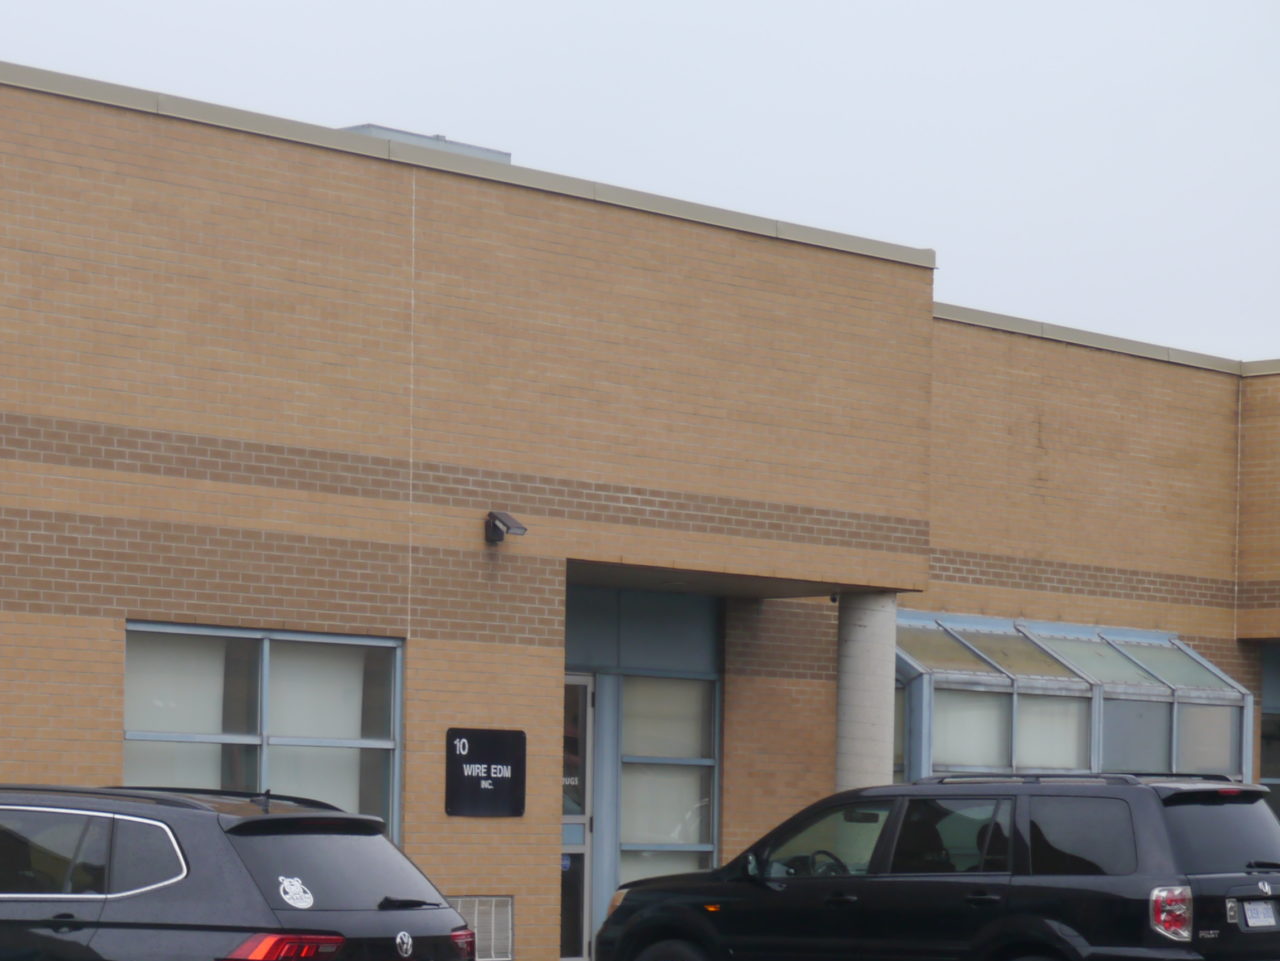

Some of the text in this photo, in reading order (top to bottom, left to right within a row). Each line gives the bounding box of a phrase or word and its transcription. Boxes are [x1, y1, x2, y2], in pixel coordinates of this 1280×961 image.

[453, 738, 469, 755] 10
[463, 764, 511, 778] WIRE EDM
